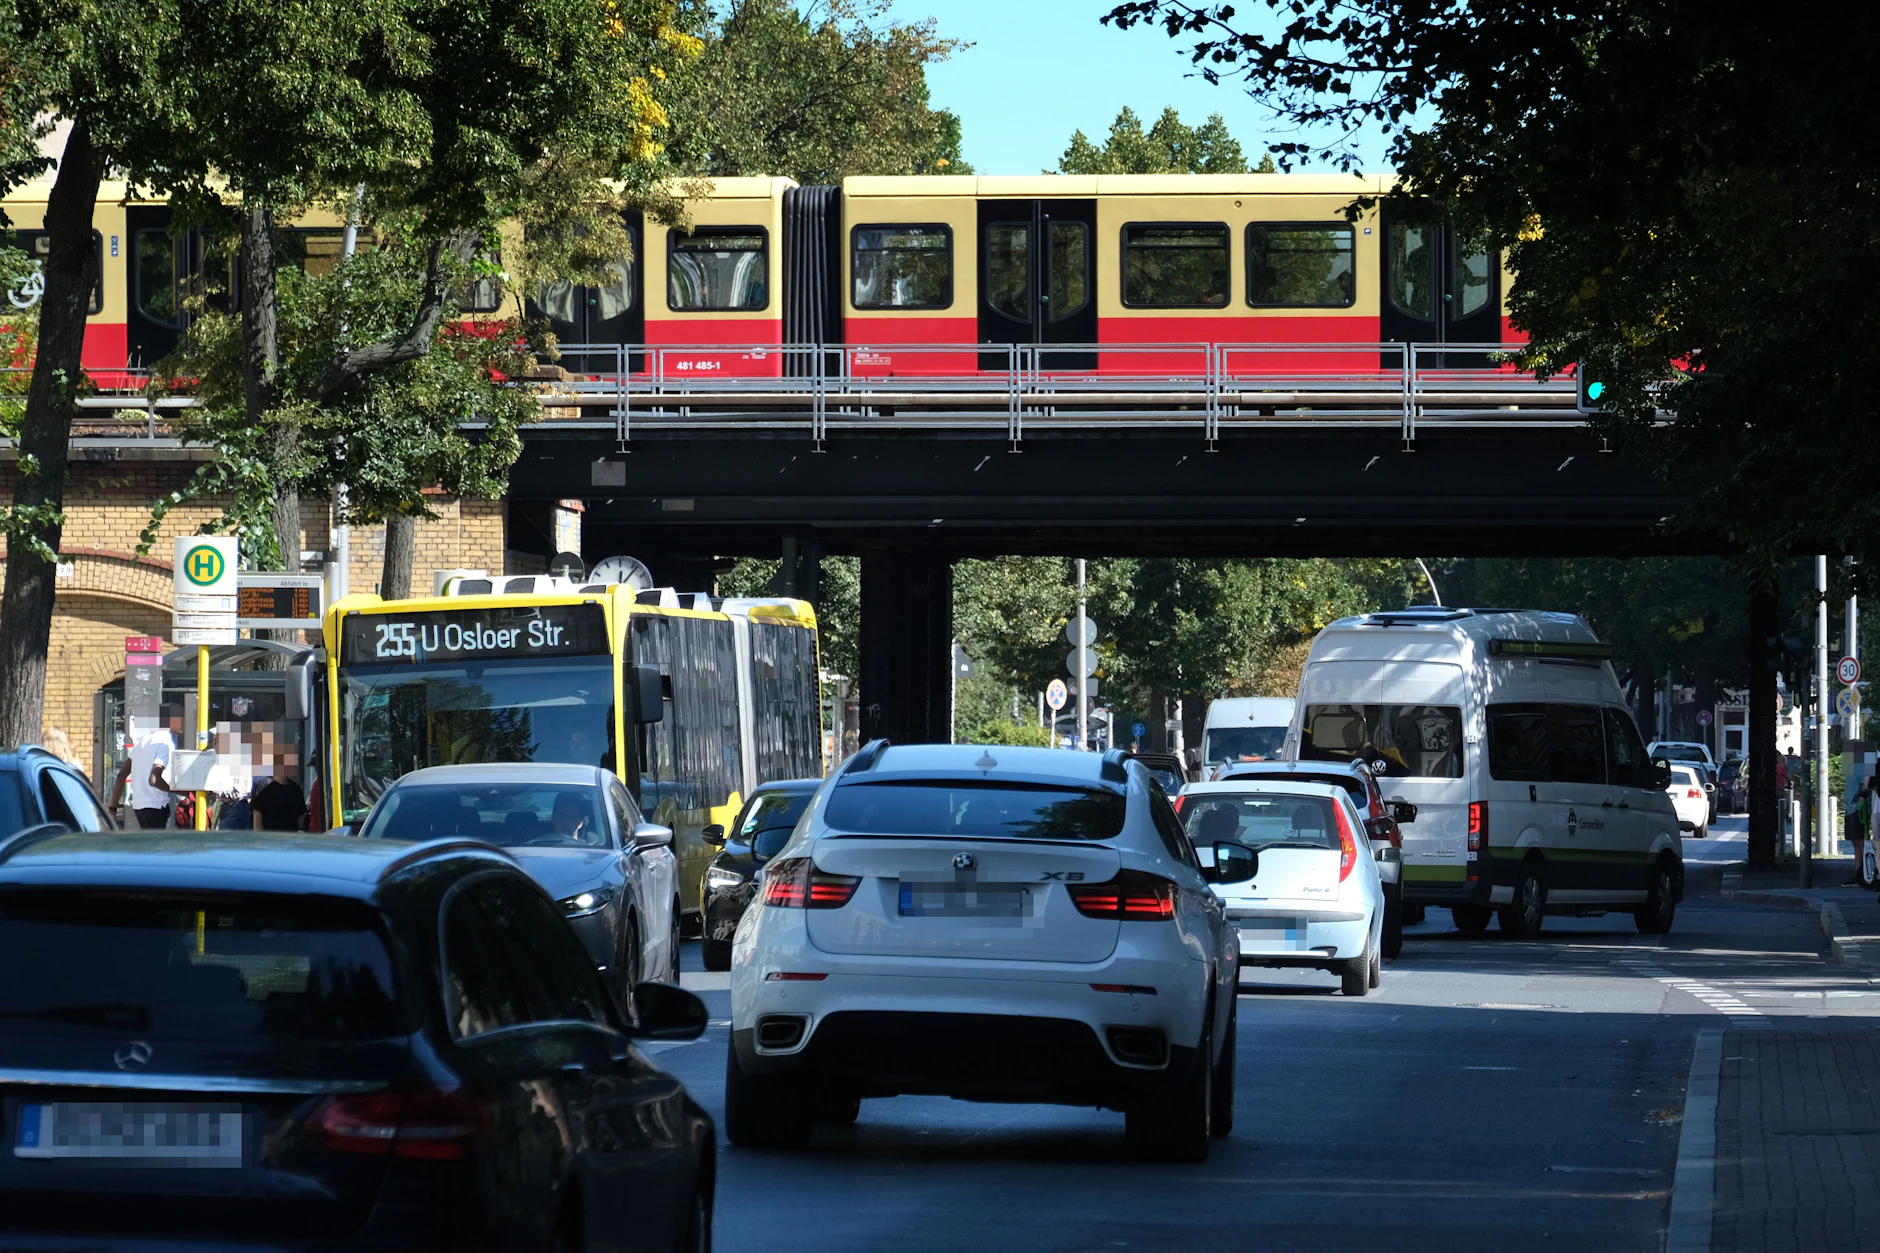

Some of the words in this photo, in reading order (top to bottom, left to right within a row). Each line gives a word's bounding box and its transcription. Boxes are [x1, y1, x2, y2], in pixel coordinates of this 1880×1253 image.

[677, 361, 693, 370] 481
[695, 361, 720, 370] 485-1
[194, 554, 214, 577] H
[376, 623, 416, 657] 255
[421, 624, 439, 652] U
[444, 622, 521, 651] Osloer
[527, 619, 570, 647] Str.
[1842, 664, 1855, 677] 30
[233, 704, 246, 714] NFL
